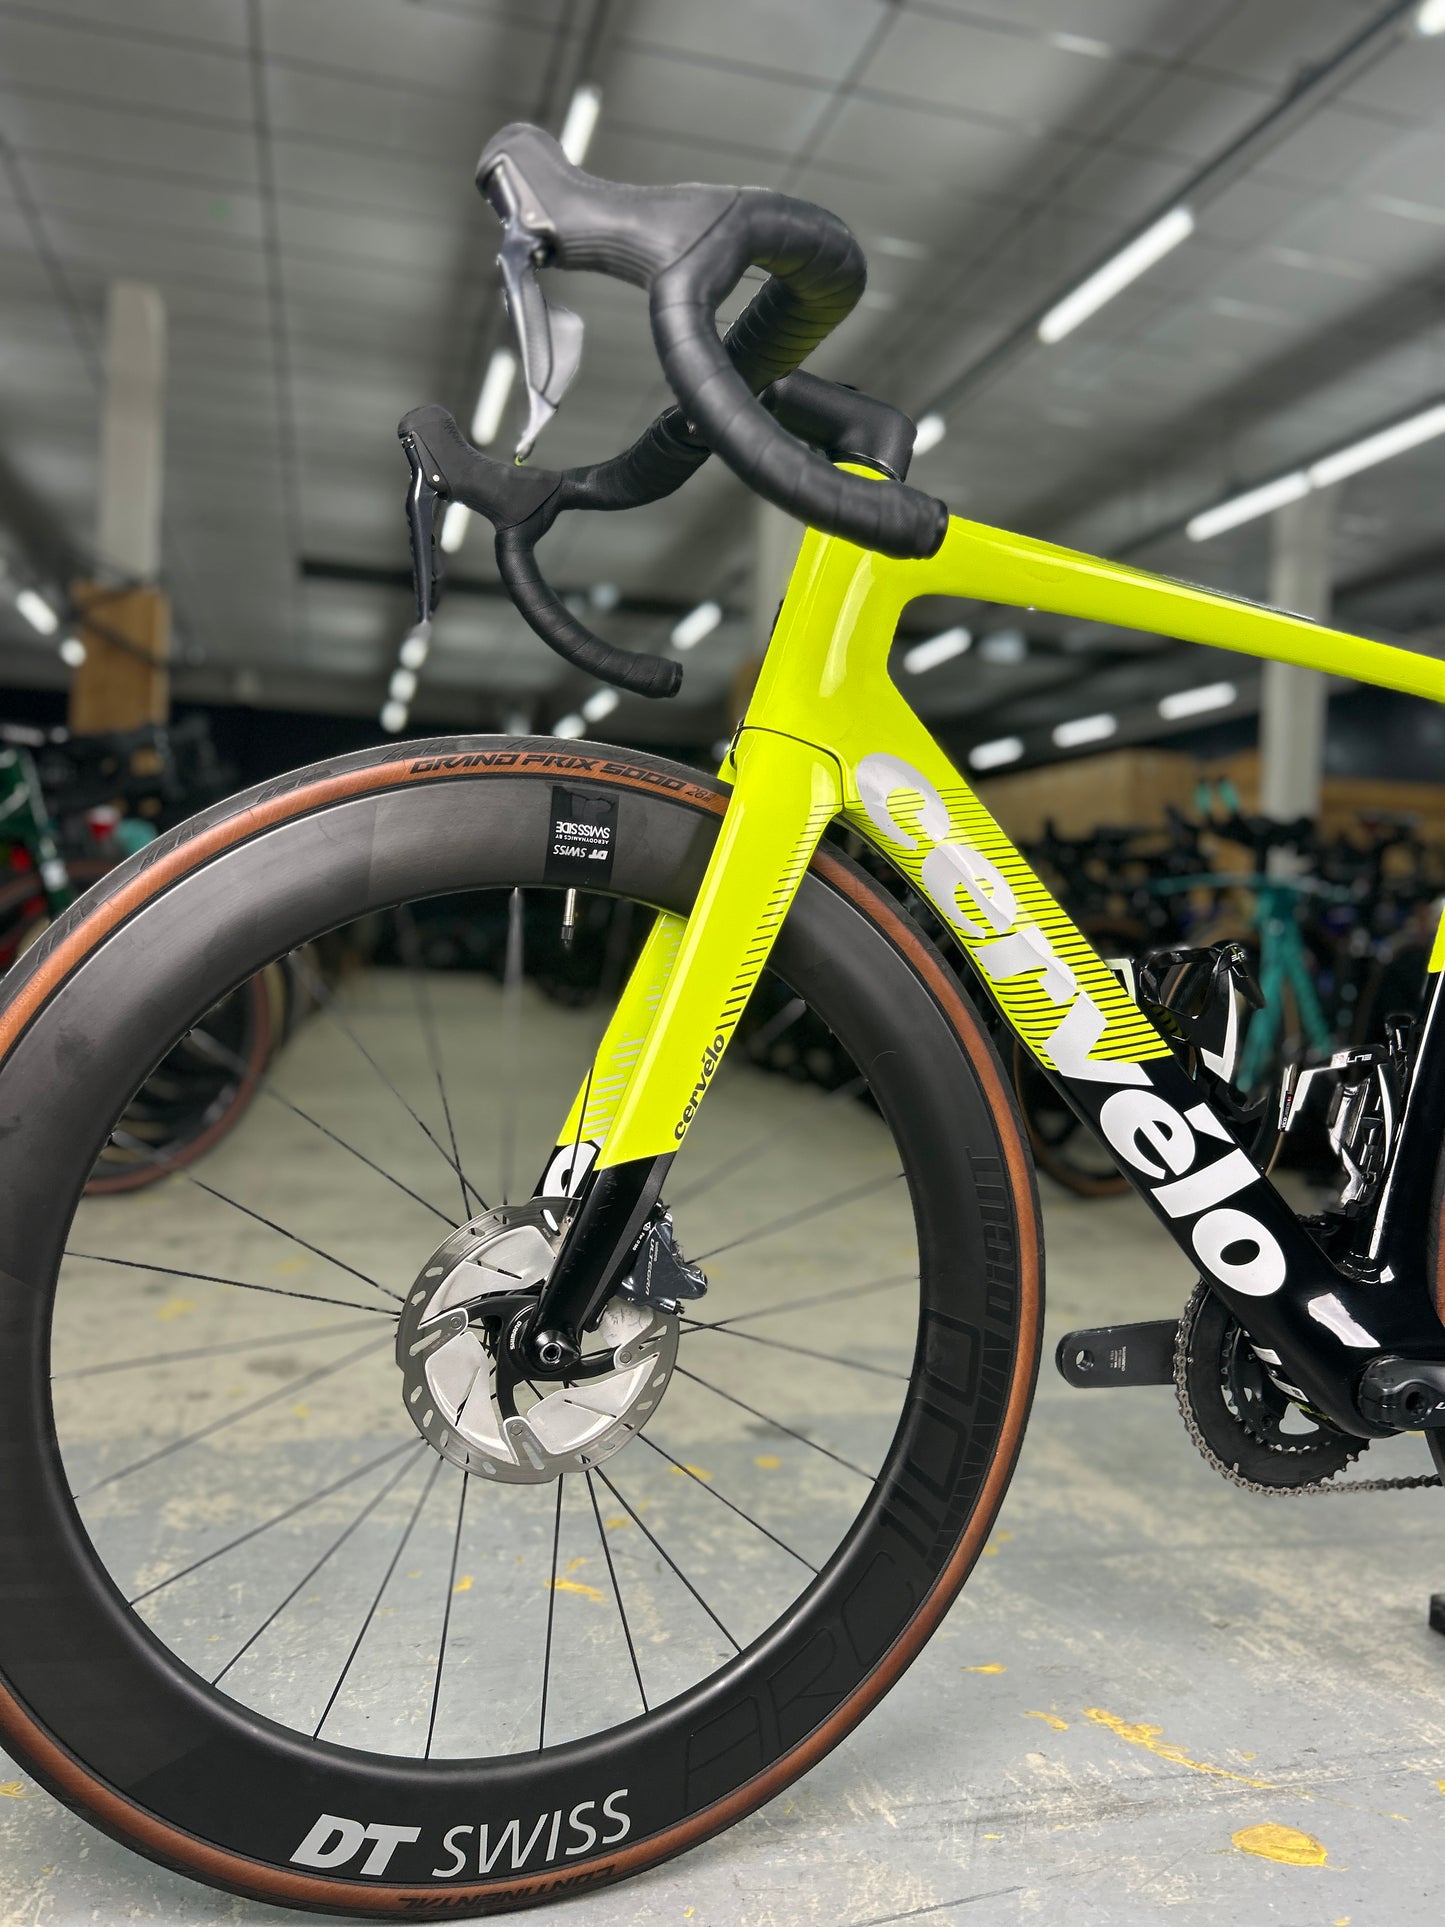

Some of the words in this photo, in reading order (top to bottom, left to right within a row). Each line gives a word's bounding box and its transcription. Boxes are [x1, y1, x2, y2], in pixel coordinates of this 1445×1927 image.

[409, 753, 519, 775] GRAND
[520, 752, 601, 772] PRIX
[600, 762, 688, 792] 5000
[552, 844, 588, 858] SWISS
[564, 833, 610, 845] AERODYNAMICS
[588, 849, 609, 861] DT
[856, 752, 1287, 1297] cervélo
[674, 1033, 725, 1141] cervélo
[645, 1237, 655, 1296] ULTEGRA
[878, 1308, 982, 1559] 1100
[289, 1813, 422, 1876] DT
[431, 1788, 631, 1878] SWISS
[399, 1864, 616, 1909] CONTINENTAL
